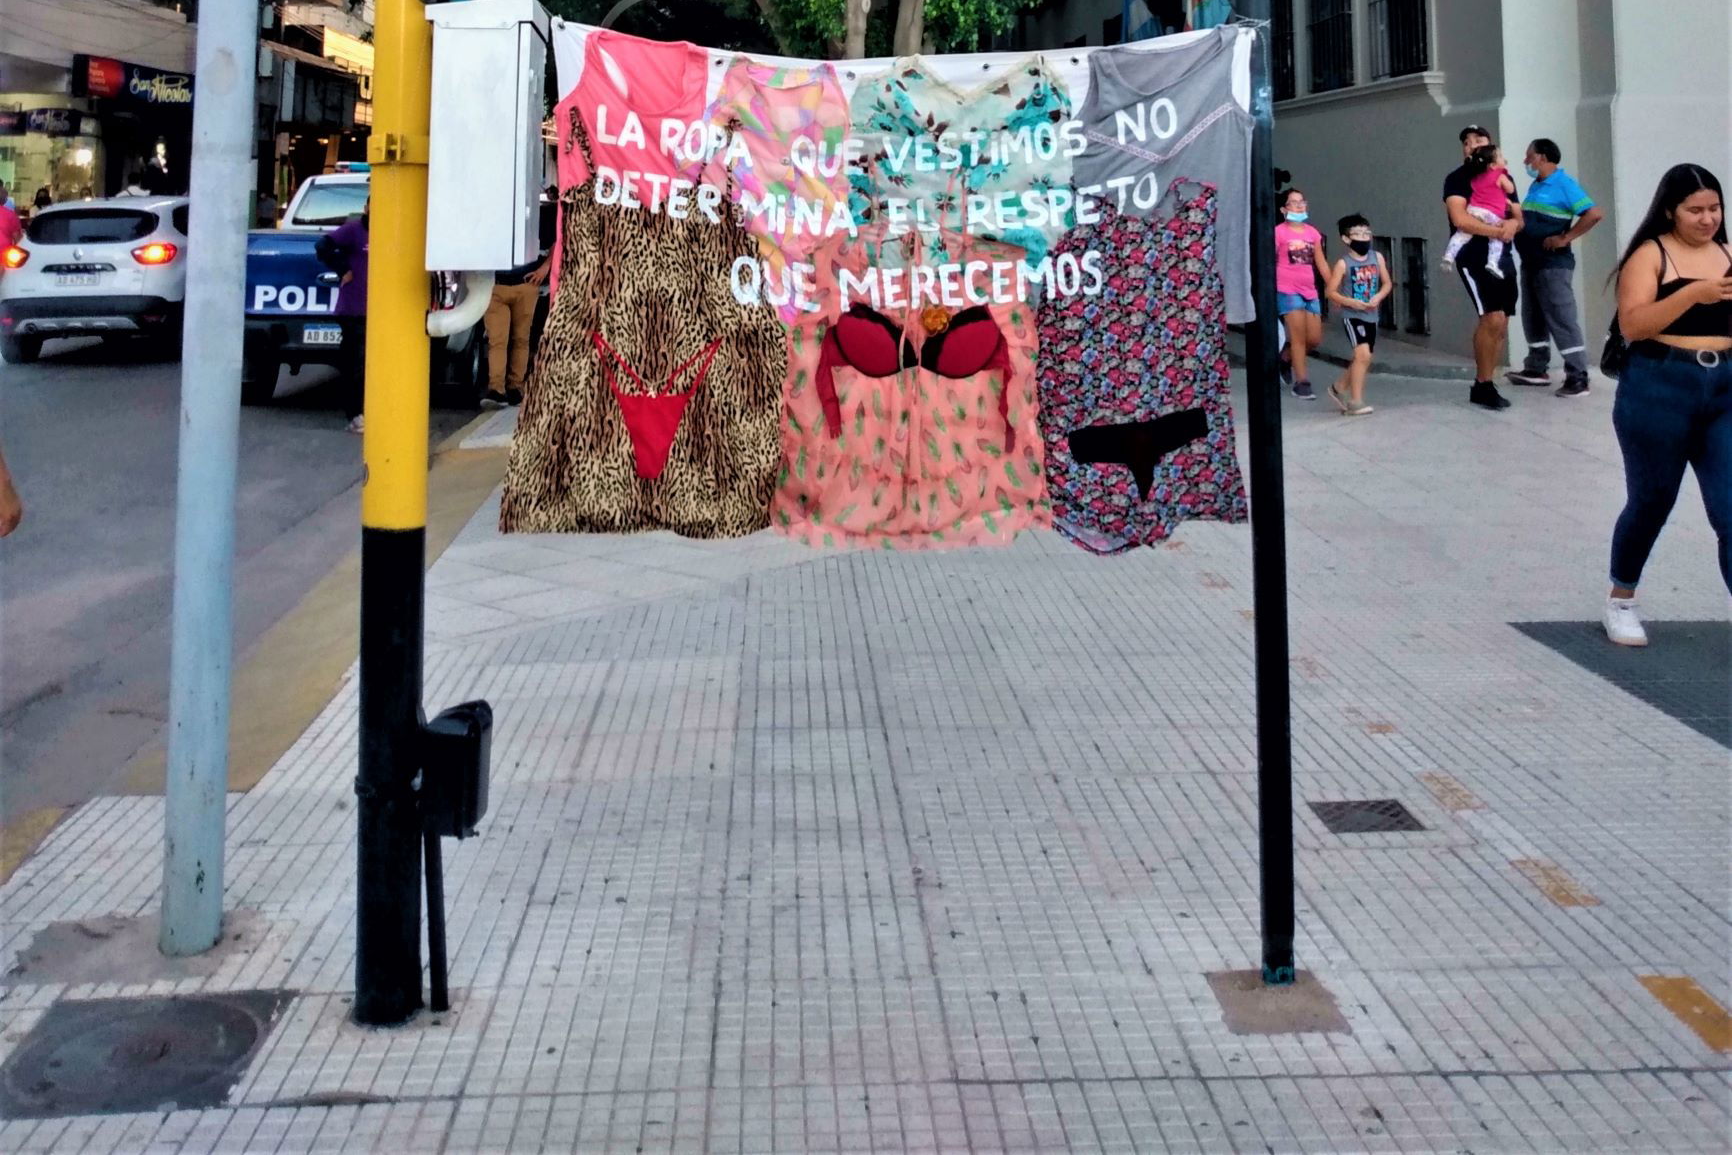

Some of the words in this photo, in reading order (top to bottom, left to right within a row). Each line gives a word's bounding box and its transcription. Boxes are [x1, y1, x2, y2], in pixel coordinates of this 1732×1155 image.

[129, 67, 151, 95] San
[597, 104, 646, 150] LA
[660, 118, 753, 167] ROPA
[791, 134, 868, 178] QUE
[1116, 98, 1177, 145] NO
[888, 198, 940, 234] EL
[967, 172, 1158, 231] RESPETO
[254, 285, 340, 313] POLI
[731, 255, 820, 312] QUE
[839, 250, 1102, 312] MERECEMOS
[306, 331, 320, 343] AD
